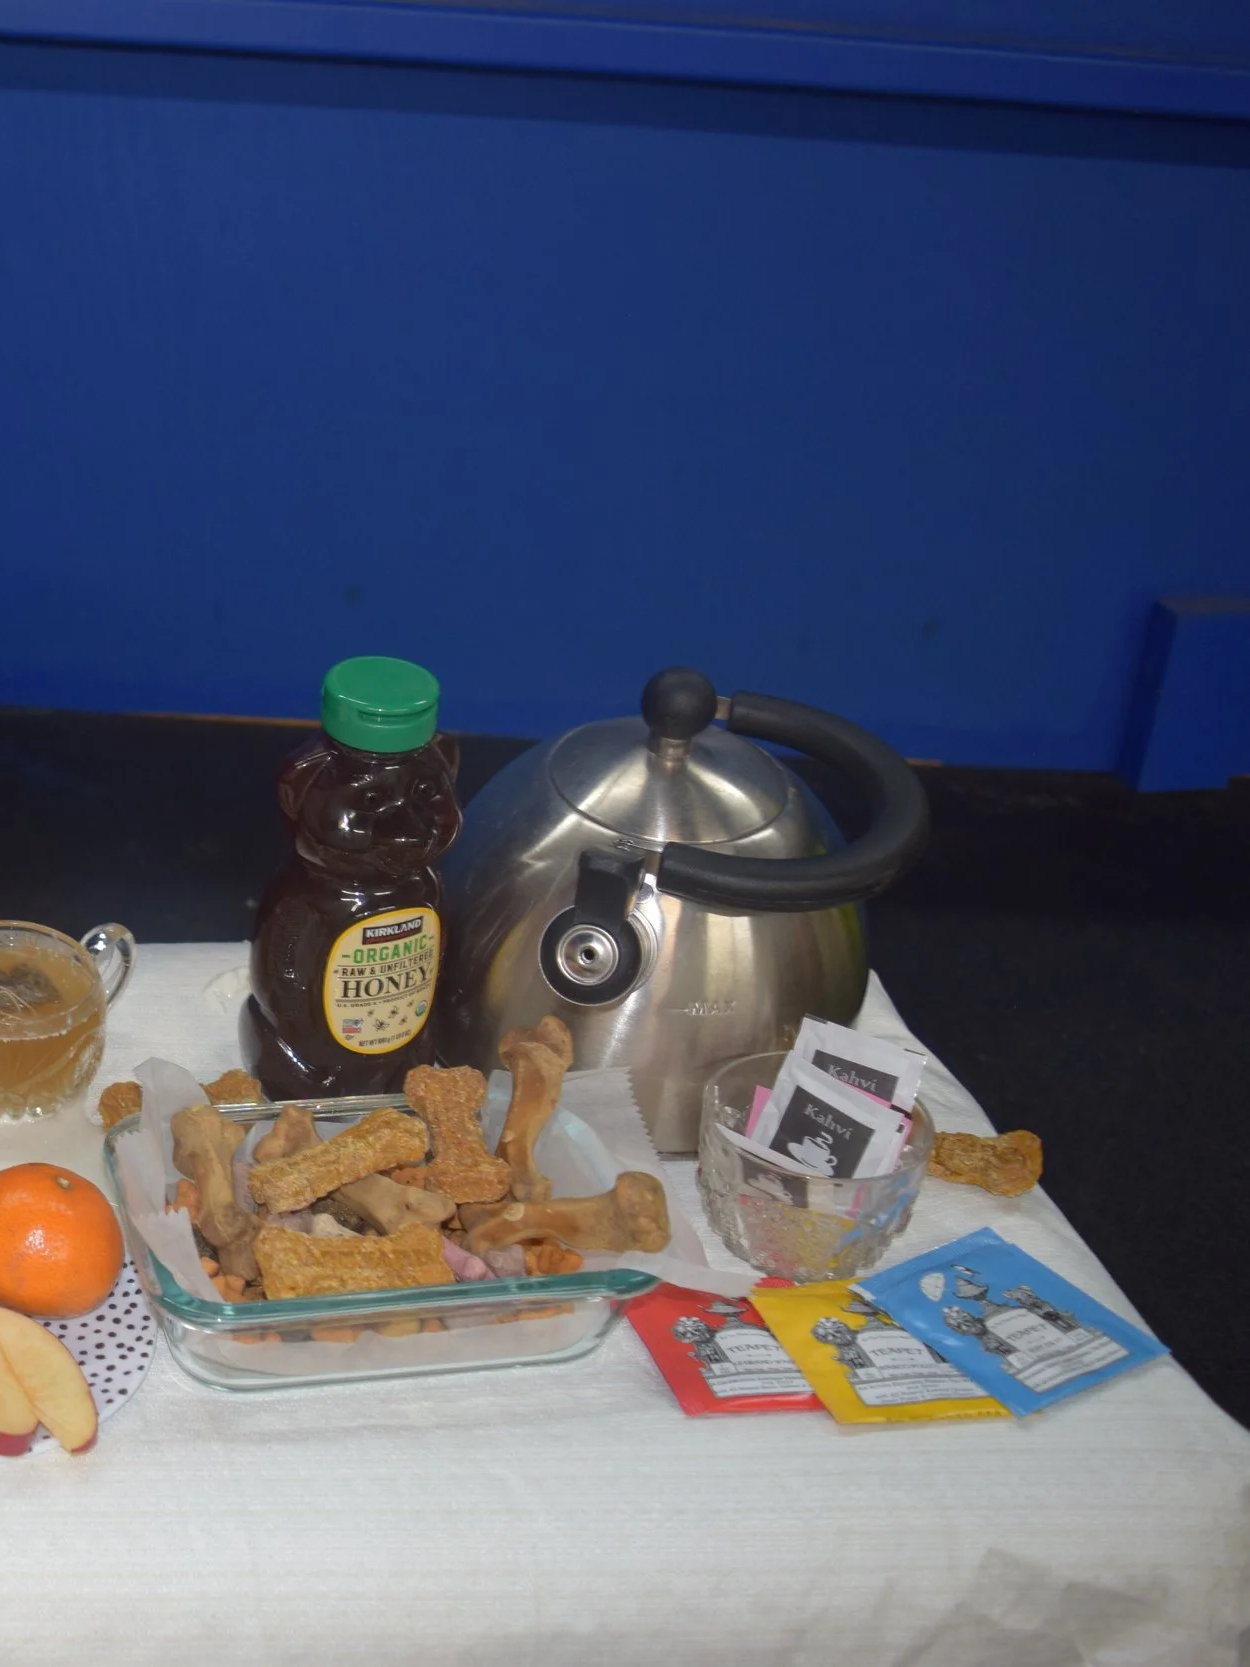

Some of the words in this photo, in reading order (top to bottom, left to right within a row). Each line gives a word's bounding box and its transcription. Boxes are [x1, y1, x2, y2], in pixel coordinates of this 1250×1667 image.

[365, 919, 422, 938] KIRKLAND
[342, 967, 367, 976] RAW
[370, 963, 376, 975] &
[380, 948, 434, 974] UNFILTERED
[353, 934, 427, 964] ORGANIC
[341, 962, 430, 998] HONEY
[828, 1064, 878, 1092] Kahvi
[804, 1104, 854, 1140] Kahvi
